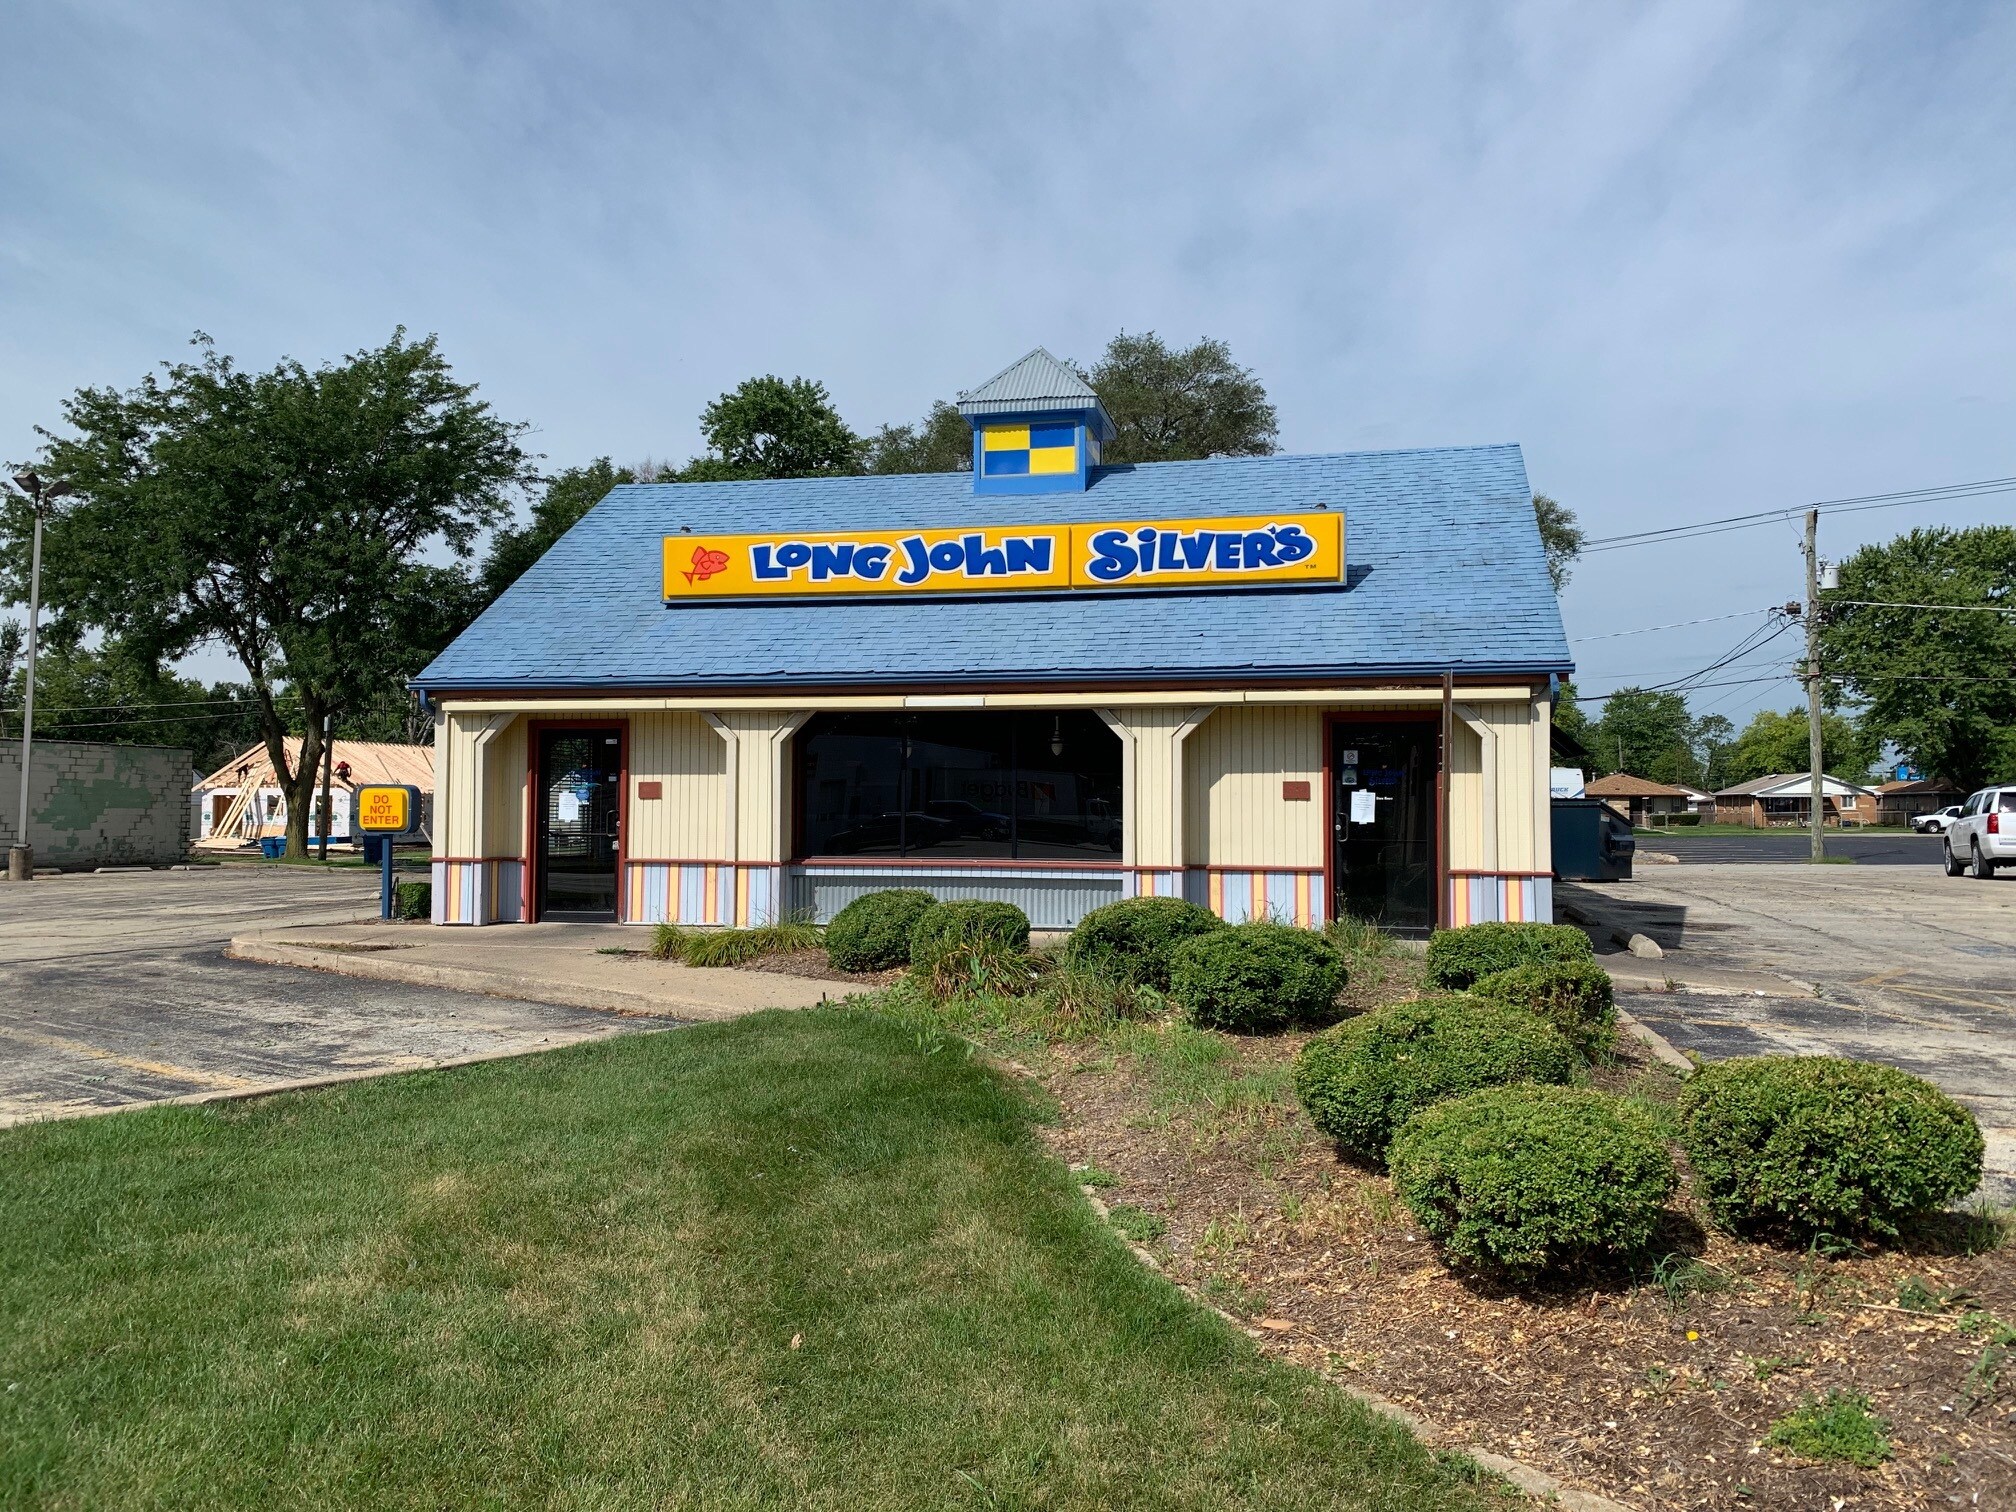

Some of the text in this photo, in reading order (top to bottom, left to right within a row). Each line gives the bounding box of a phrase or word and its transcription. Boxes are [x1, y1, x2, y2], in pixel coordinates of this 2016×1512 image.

[373, 794, 389, 804] DO
[369, 805, 392, 815] NOT
[362, 815, 399, 825] ENTER
